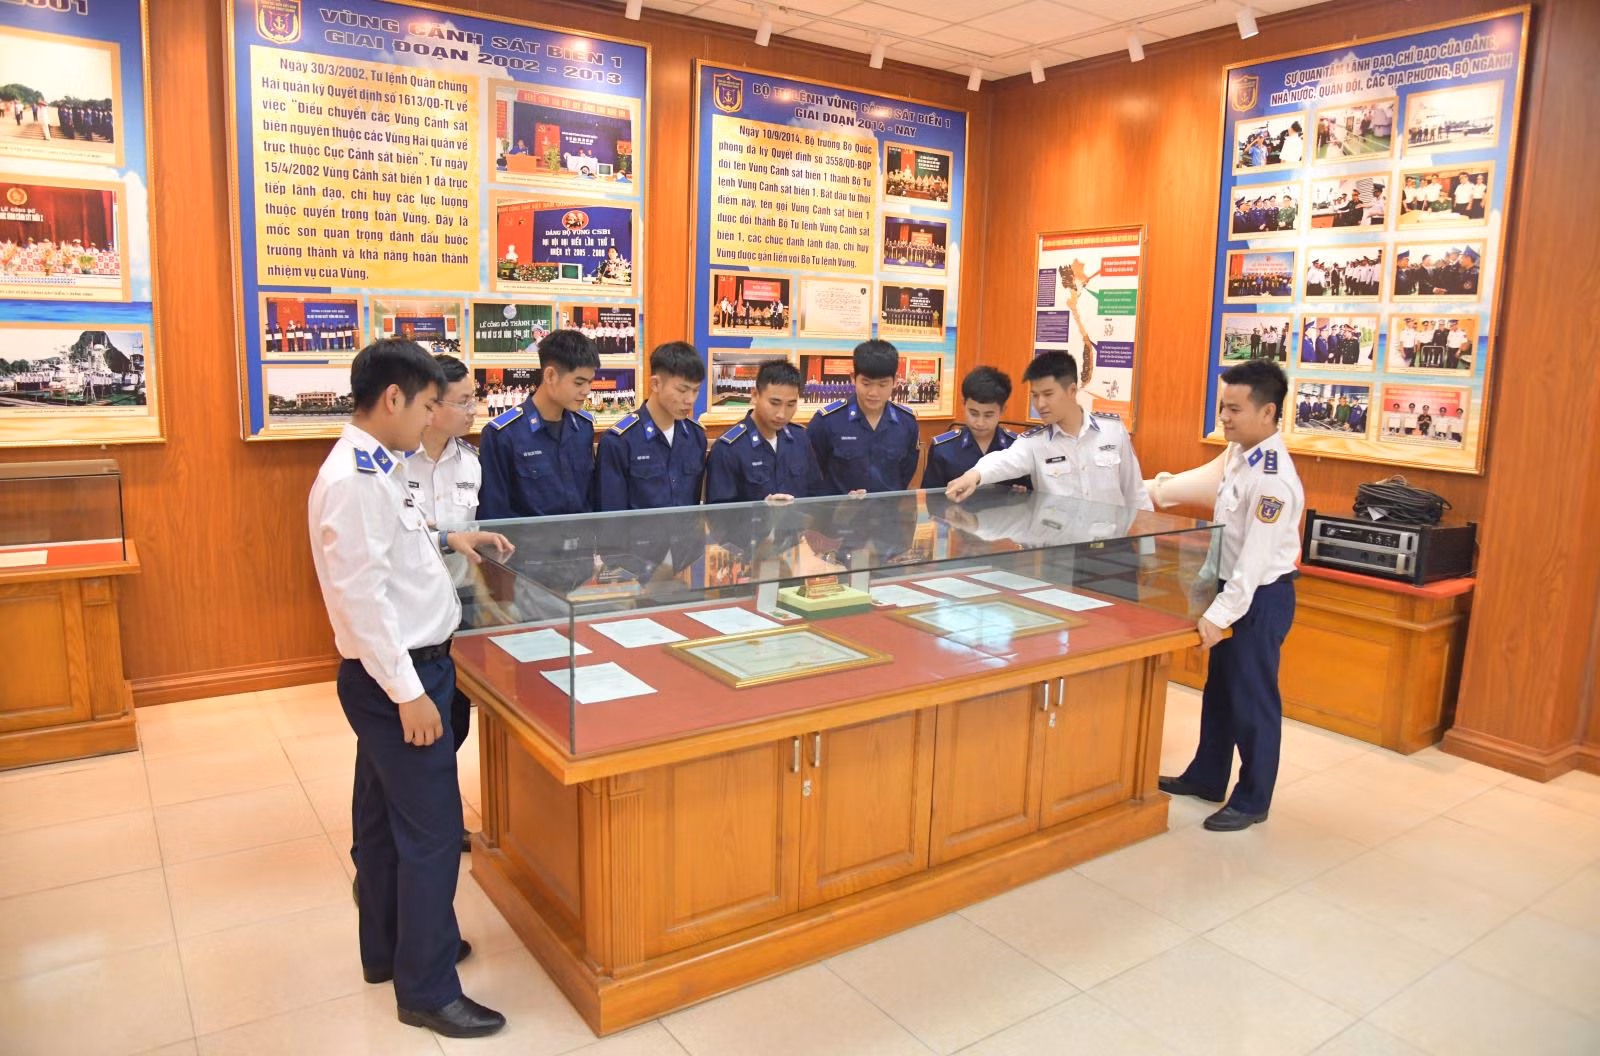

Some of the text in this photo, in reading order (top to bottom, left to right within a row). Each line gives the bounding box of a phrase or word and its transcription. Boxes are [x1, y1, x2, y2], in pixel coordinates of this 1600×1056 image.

[320, 8, 399, 33] VÙNG
[491, 36, 540, 54] SÁT
[611, 56, 621, 68] 1
[325, 29, 384, 50] GIAI
[392, 39, 469, 61] ĐOẠN
[477, 52, 539, 72] 2002
[563, 65, 622, 84] 2013
[1299, 67, 1323, 84] QUAN
[753, 83, 770, 98] BỘ
[945, 119, 950, 128] 1
[795, 107, 819, 120] GIAI
[822, 112, 855, 127] ĐOẠN
[858, 119, 885, 132] 2014
[895, 124, 917, 137] NAY
